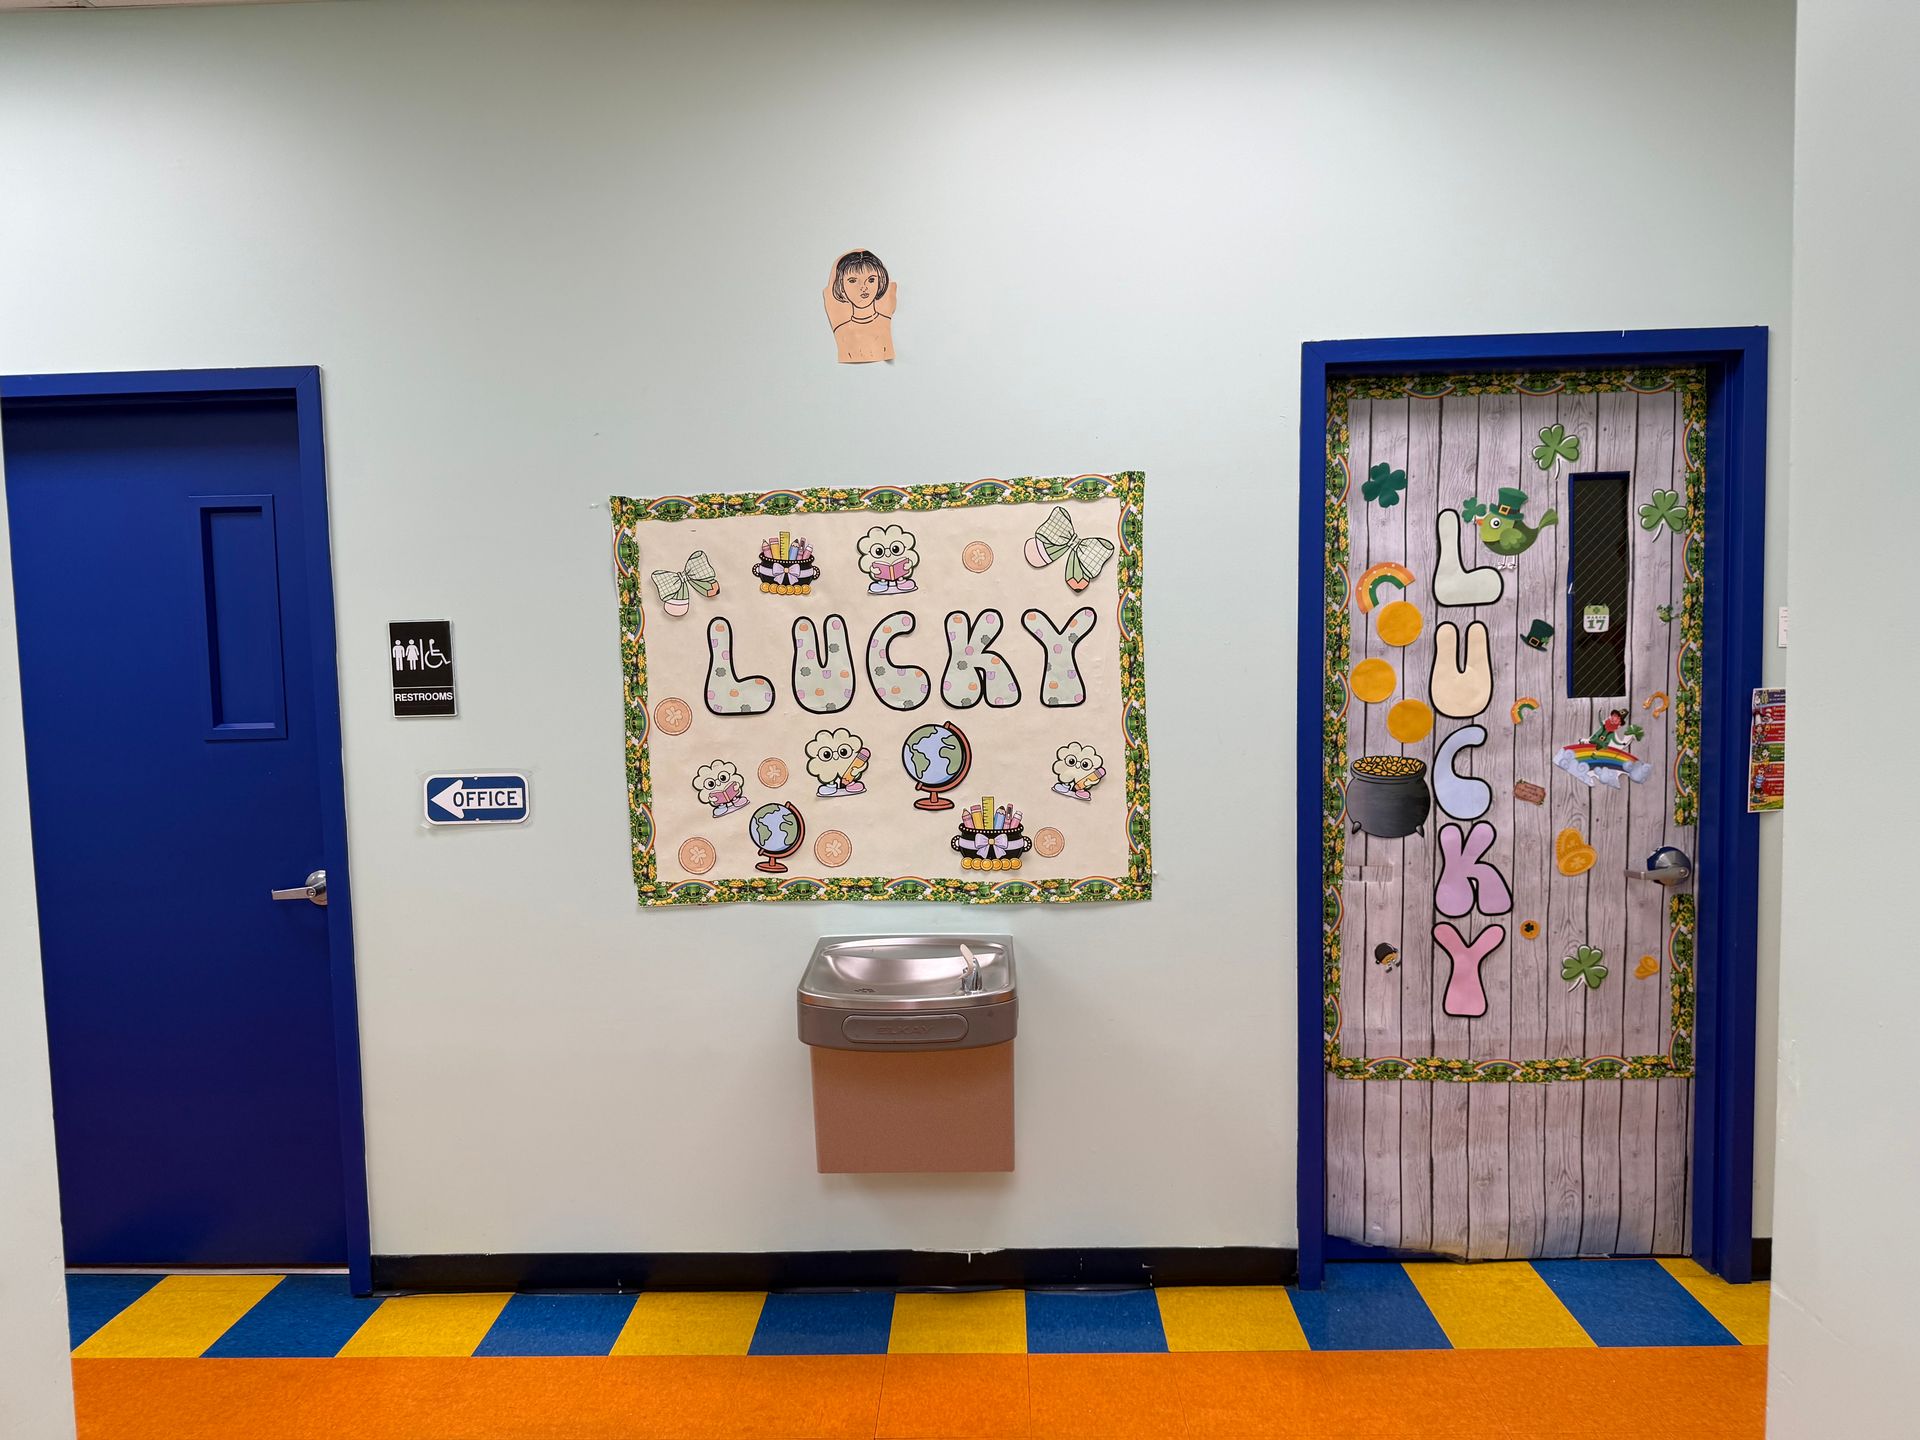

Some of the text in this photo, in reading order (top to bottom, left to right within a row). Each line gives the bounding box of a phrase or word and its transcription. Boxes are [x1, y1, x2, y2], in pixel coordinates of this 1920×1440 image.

[1587, 619, 1605, 630] 17
[704, 606, 1098, 715] LUCKY
[395, 692, 453, 702] RESTROOMS
[1429, 508, 1513, 1018] LUCKY
[453, 791, 517, 807] OFFICE
